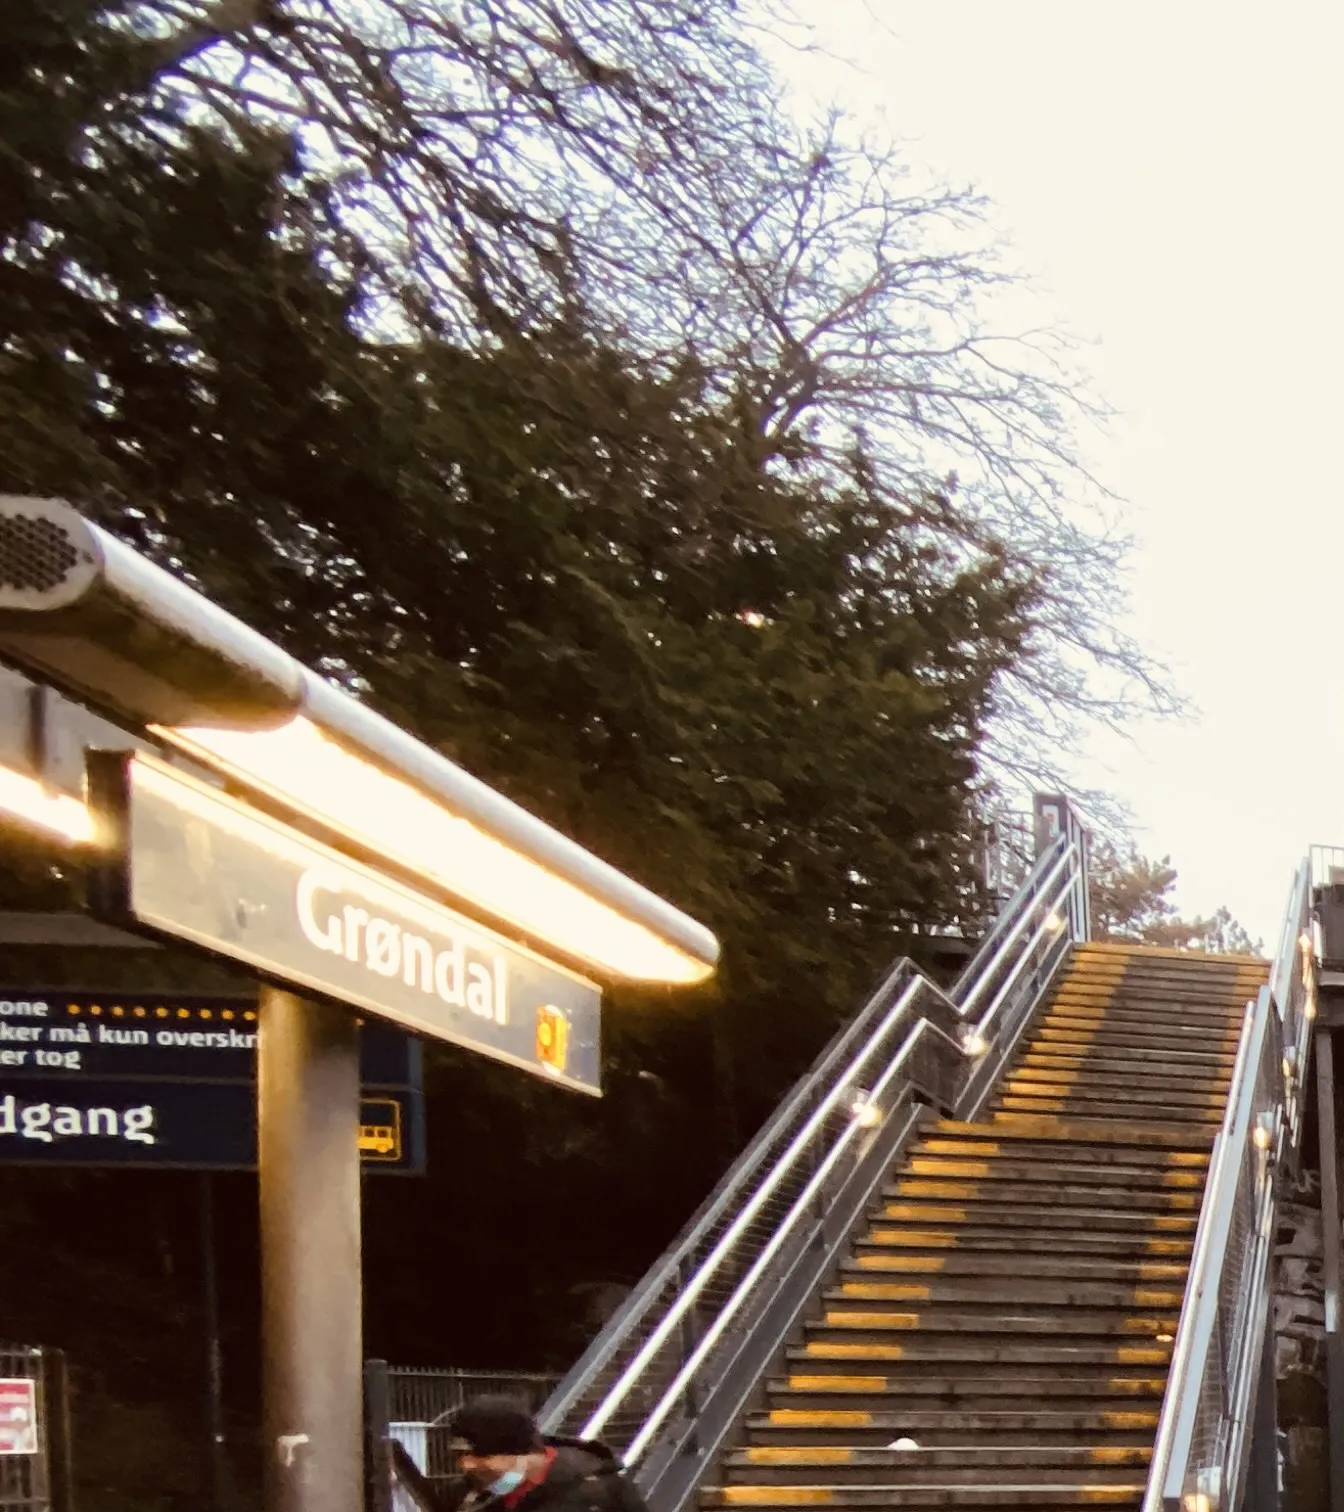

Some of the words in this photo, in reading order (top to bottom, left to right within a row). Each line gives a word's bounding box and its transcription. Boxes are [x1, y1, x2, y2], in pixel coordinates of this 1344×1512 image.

[296, 866, 508, 1025] Grøndal
[0, 1001, 49, 1017] one
[0, 1021, 43, 1042] ker
[50, 1022, 92, 1044] må
[100, 1024, 149, 1045] kun
[35, 1049, 81, 1070] tog
